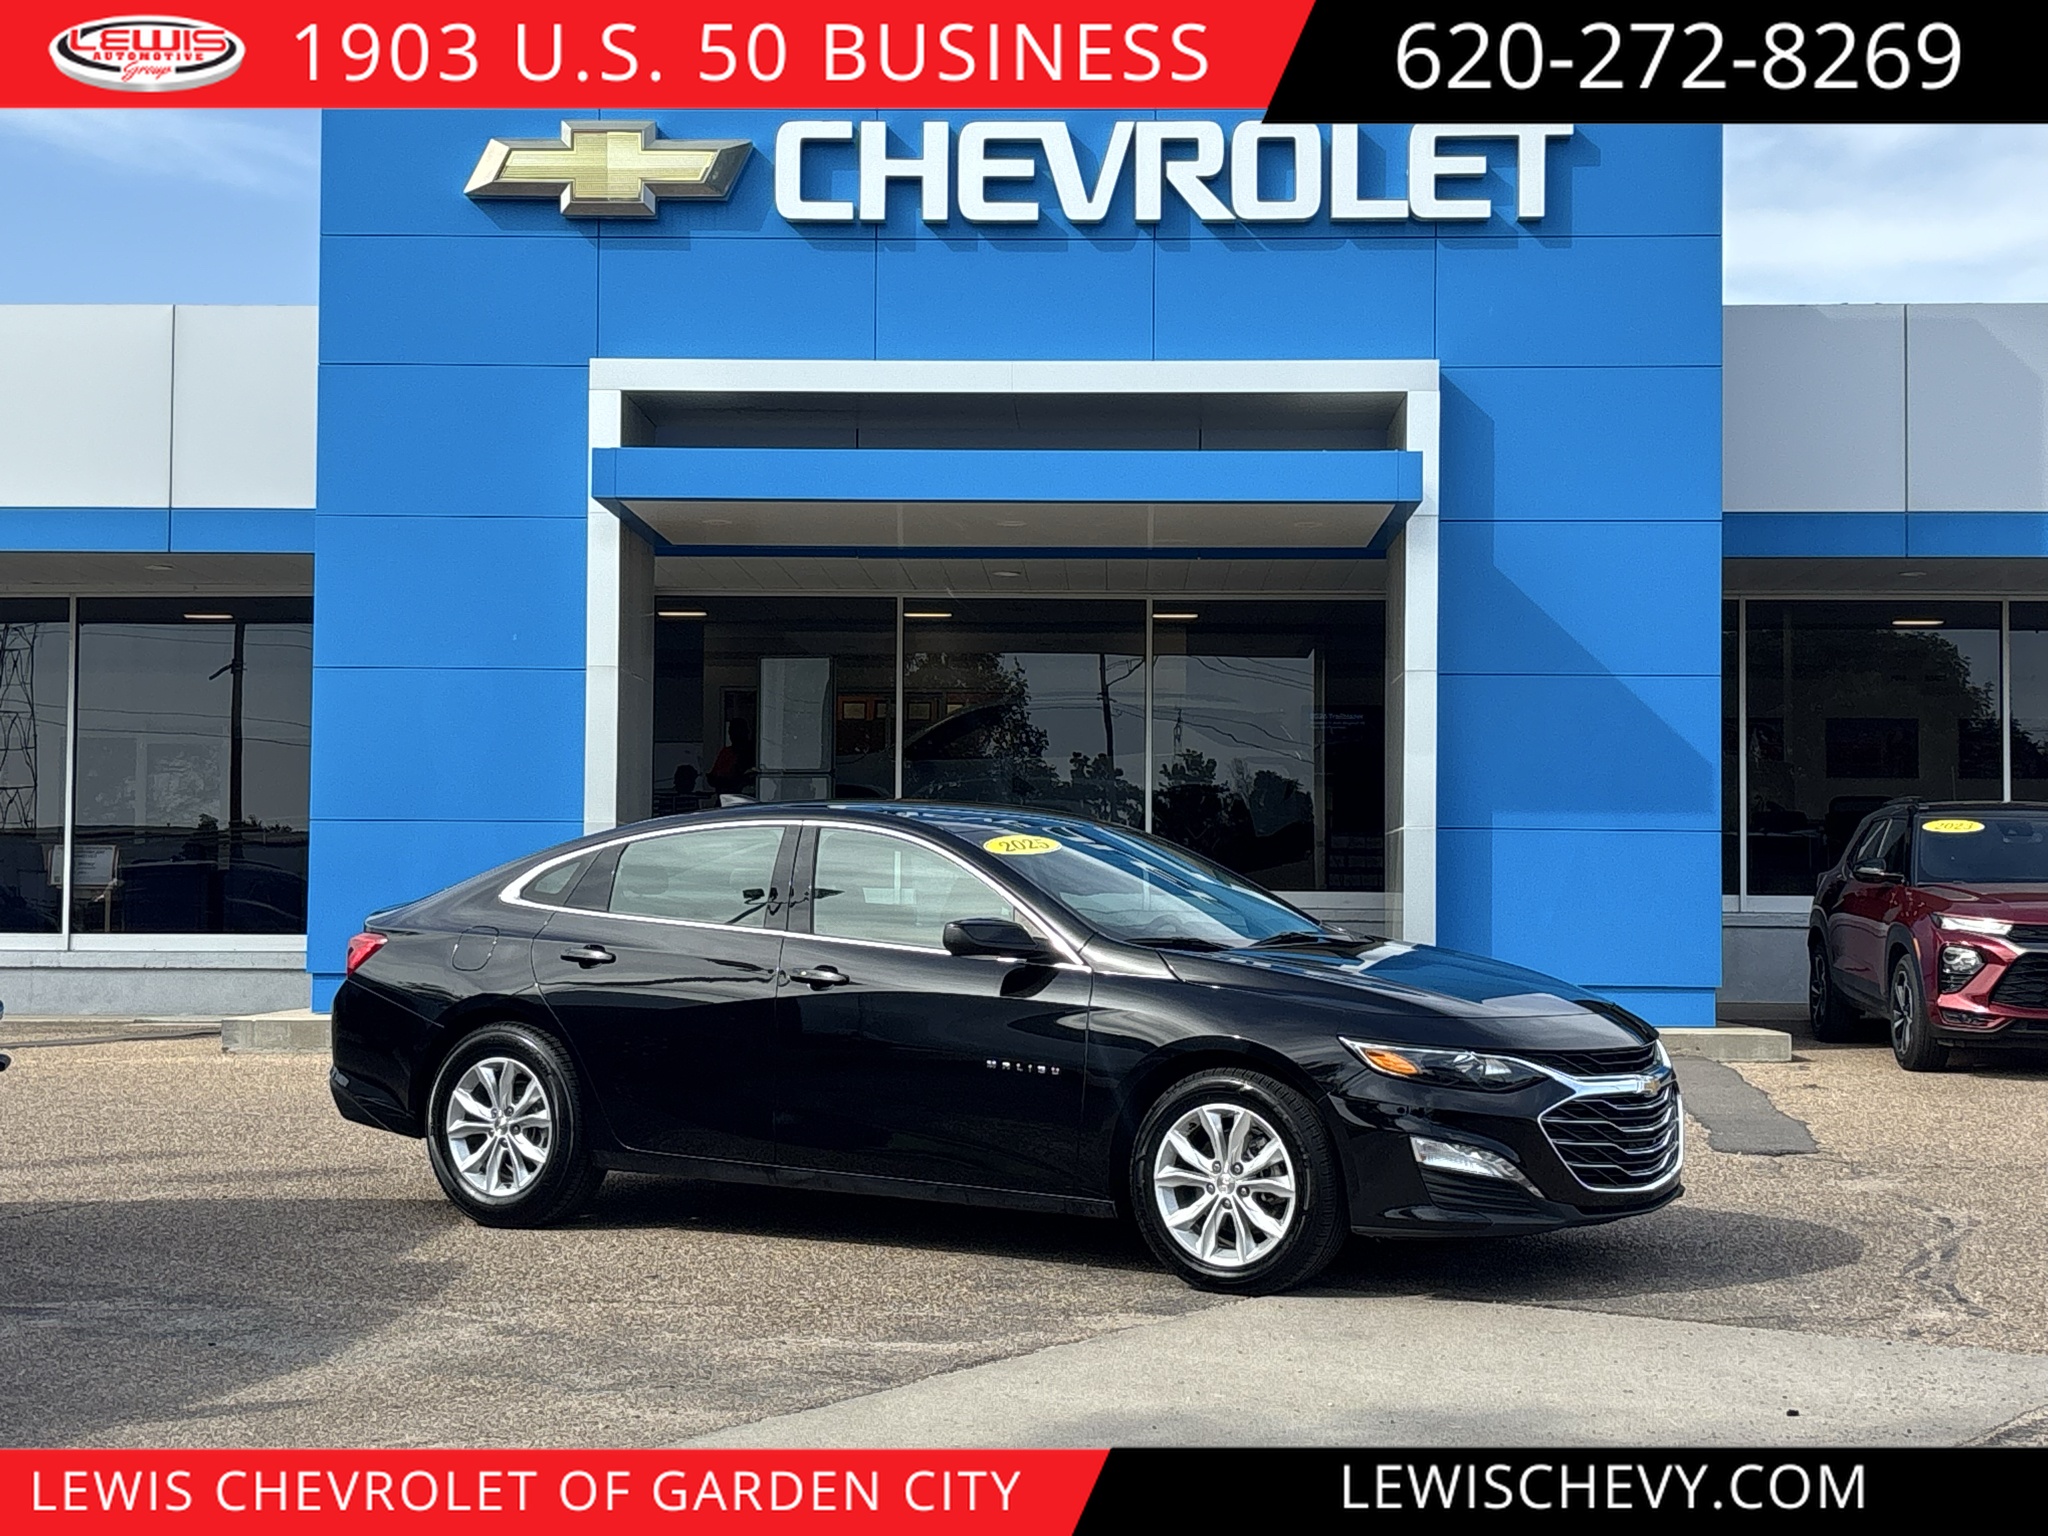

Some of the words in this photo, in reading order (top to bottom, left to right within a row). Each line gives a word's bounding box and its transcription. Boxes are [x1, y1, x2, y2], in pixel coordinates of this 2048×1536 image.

[775, 120, 1574, 222] CHEVROLET
[998, 838, 1050, 852] 2025
[986, 1059, 1060, 1076] MALIBU
